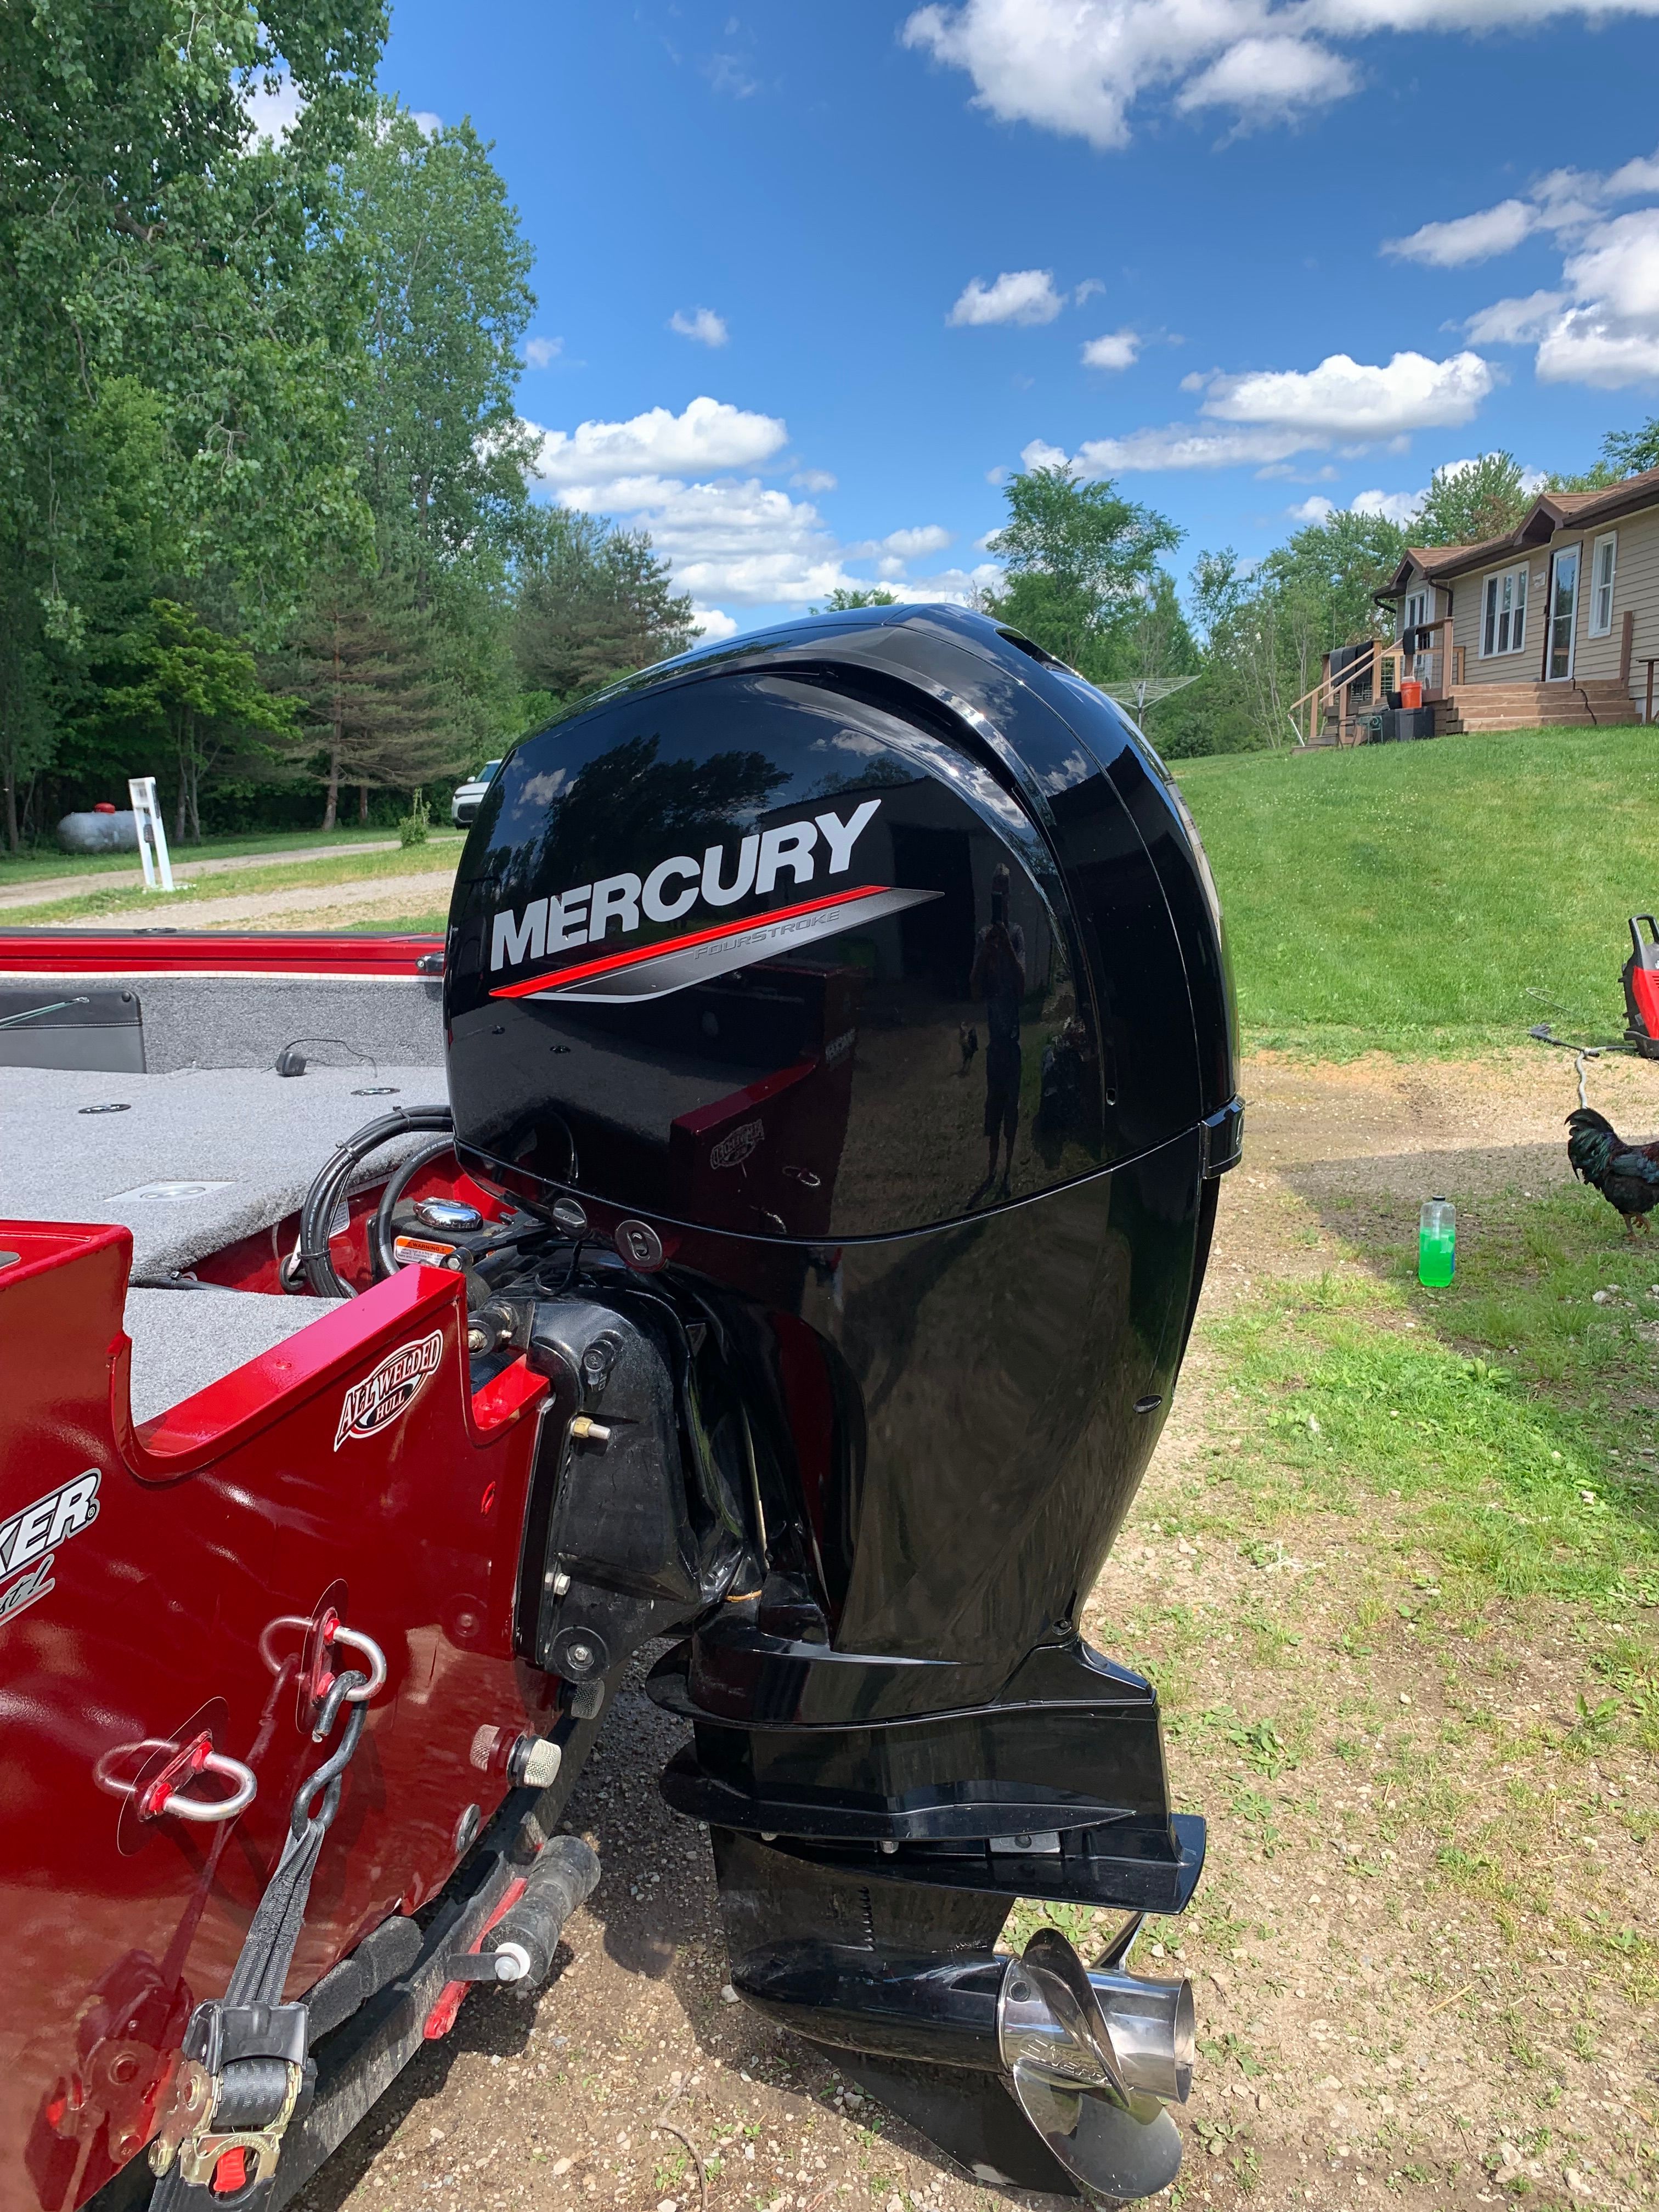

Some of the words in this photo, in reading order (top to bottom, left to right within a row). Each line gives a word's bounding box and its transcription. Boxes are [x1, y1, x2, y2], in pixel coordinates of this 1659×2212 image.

[490, 798, 882, 972] MERCURY
[693, 909, 840, 960] FOURSTROKE
[413, 1243, 439, 1251] WARNING
[337, 1381, 375, 1440] ALL
[377, 1336, 441, 1398] WELDED
[375, 1389, 405, 1423] HULL
